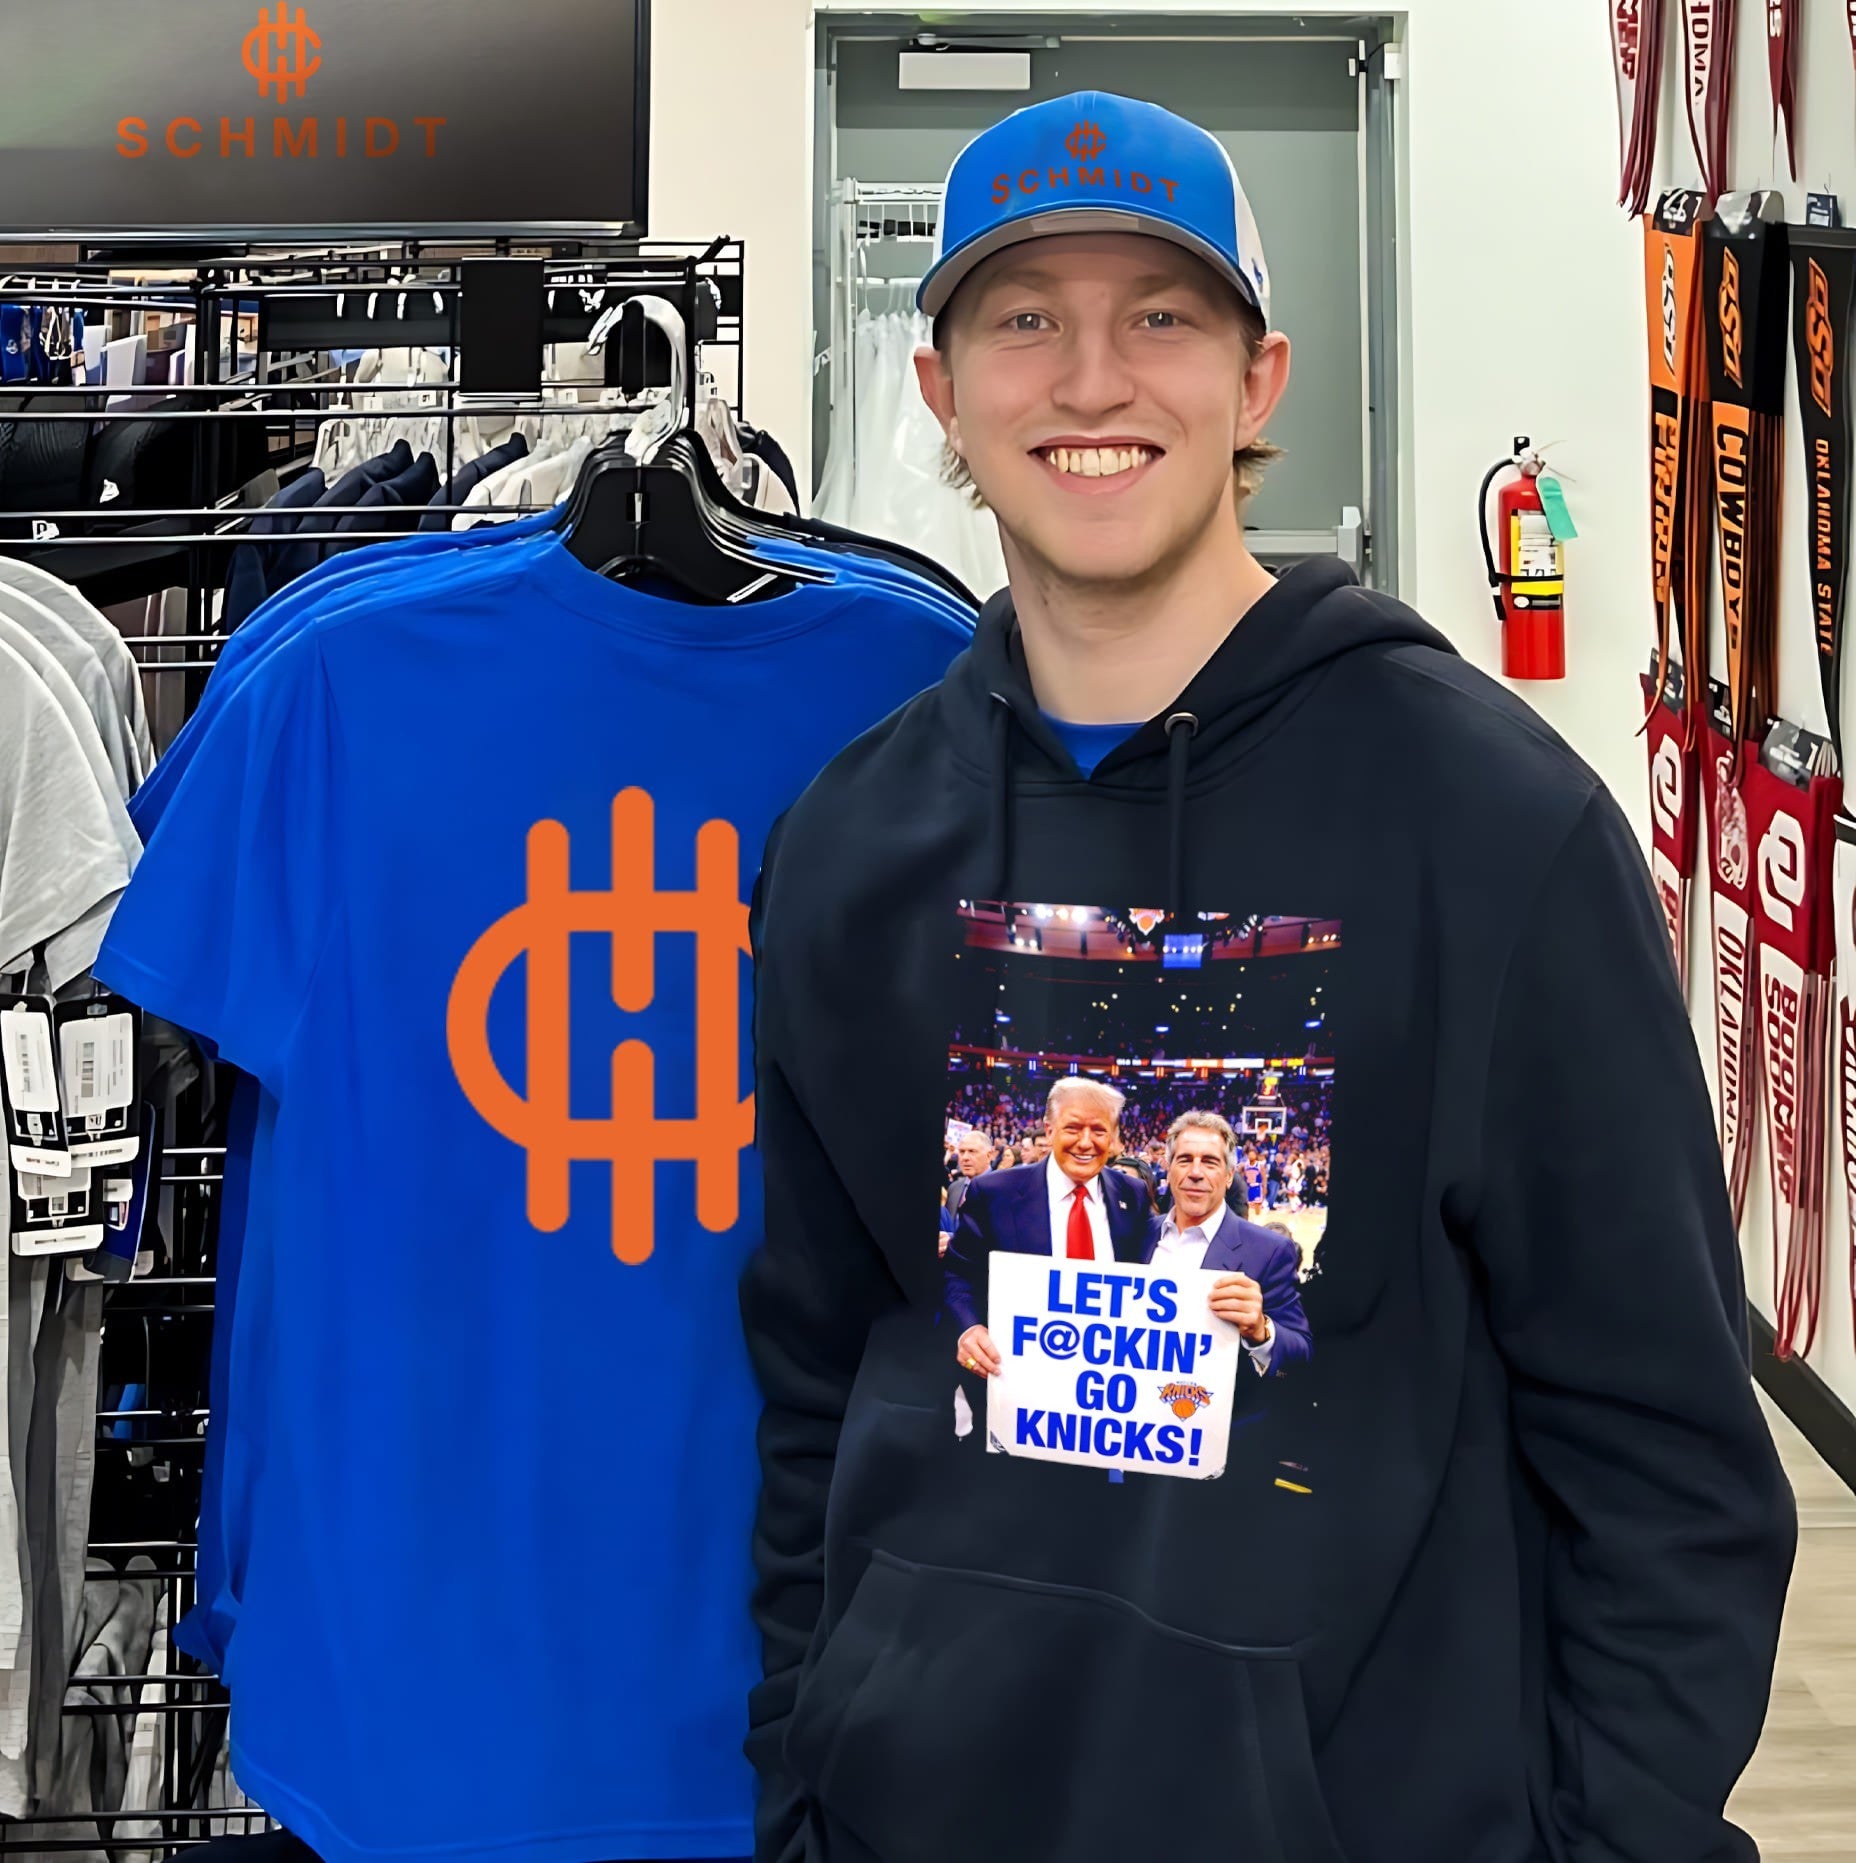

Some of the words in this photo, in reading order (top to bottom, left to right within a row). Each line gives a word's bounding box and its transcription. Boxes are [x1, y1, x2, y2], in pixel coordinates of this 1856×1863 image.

[115, 116, 448, 159] SCHMIDT
[991, 167, 1179, 205] SCHMIDT
[1815, 438, 1832, 571] OKLAHOMA
[1048, 1269, 1179, 1324] LET'S
[1075, 1370, 1138, 1413] GO
[1015, 1407, 1203, 1466] KNICKS!
